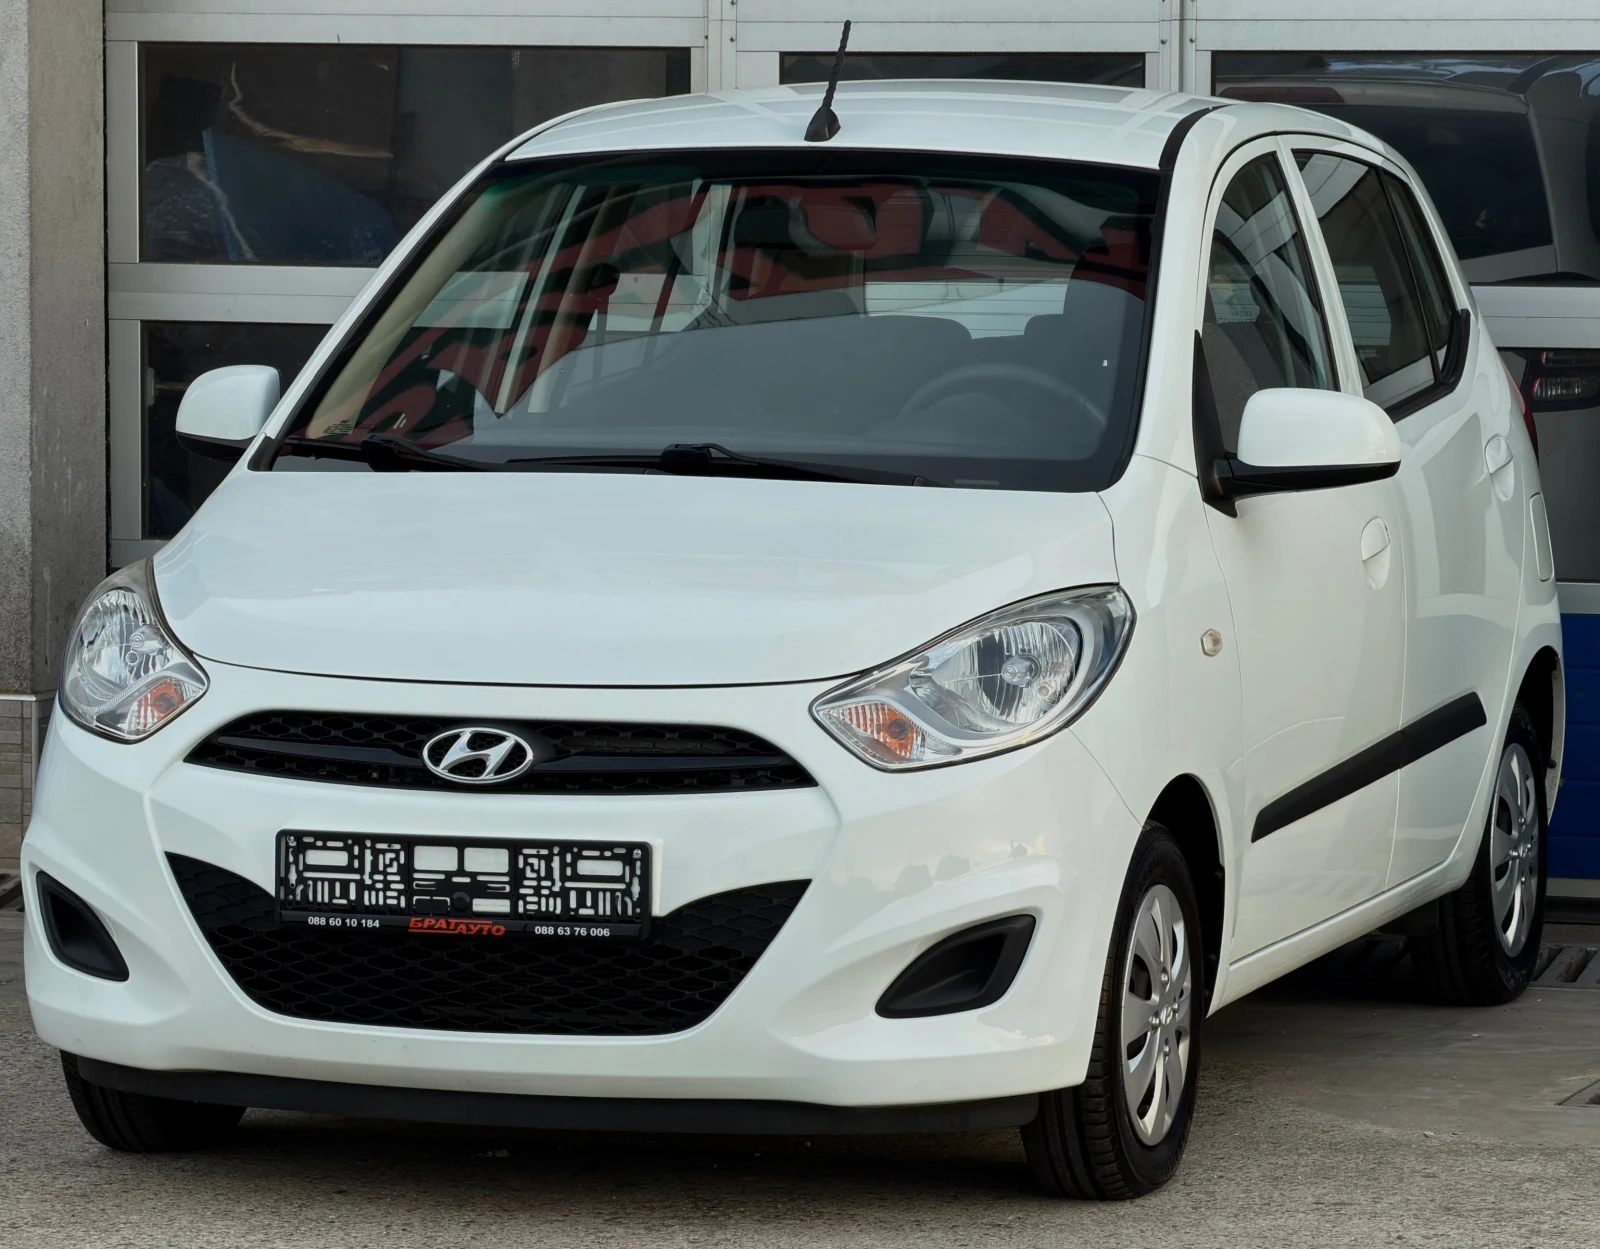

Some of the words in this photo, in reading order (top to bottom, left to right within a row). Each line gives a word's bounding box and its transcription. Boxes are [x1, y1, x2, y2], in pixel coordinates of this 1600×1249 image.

[308, 916, 326, 926] 088
[329, 917, 342, 926] 60
[345, 918, 357, 927] 10
[361, 919, 380, 928] 184
[535, 926, 554, 935] 088
[557, 926, 571, 936] 63
[573, 927, 587, 936] 76
[590, 928, 610, 937] 006
